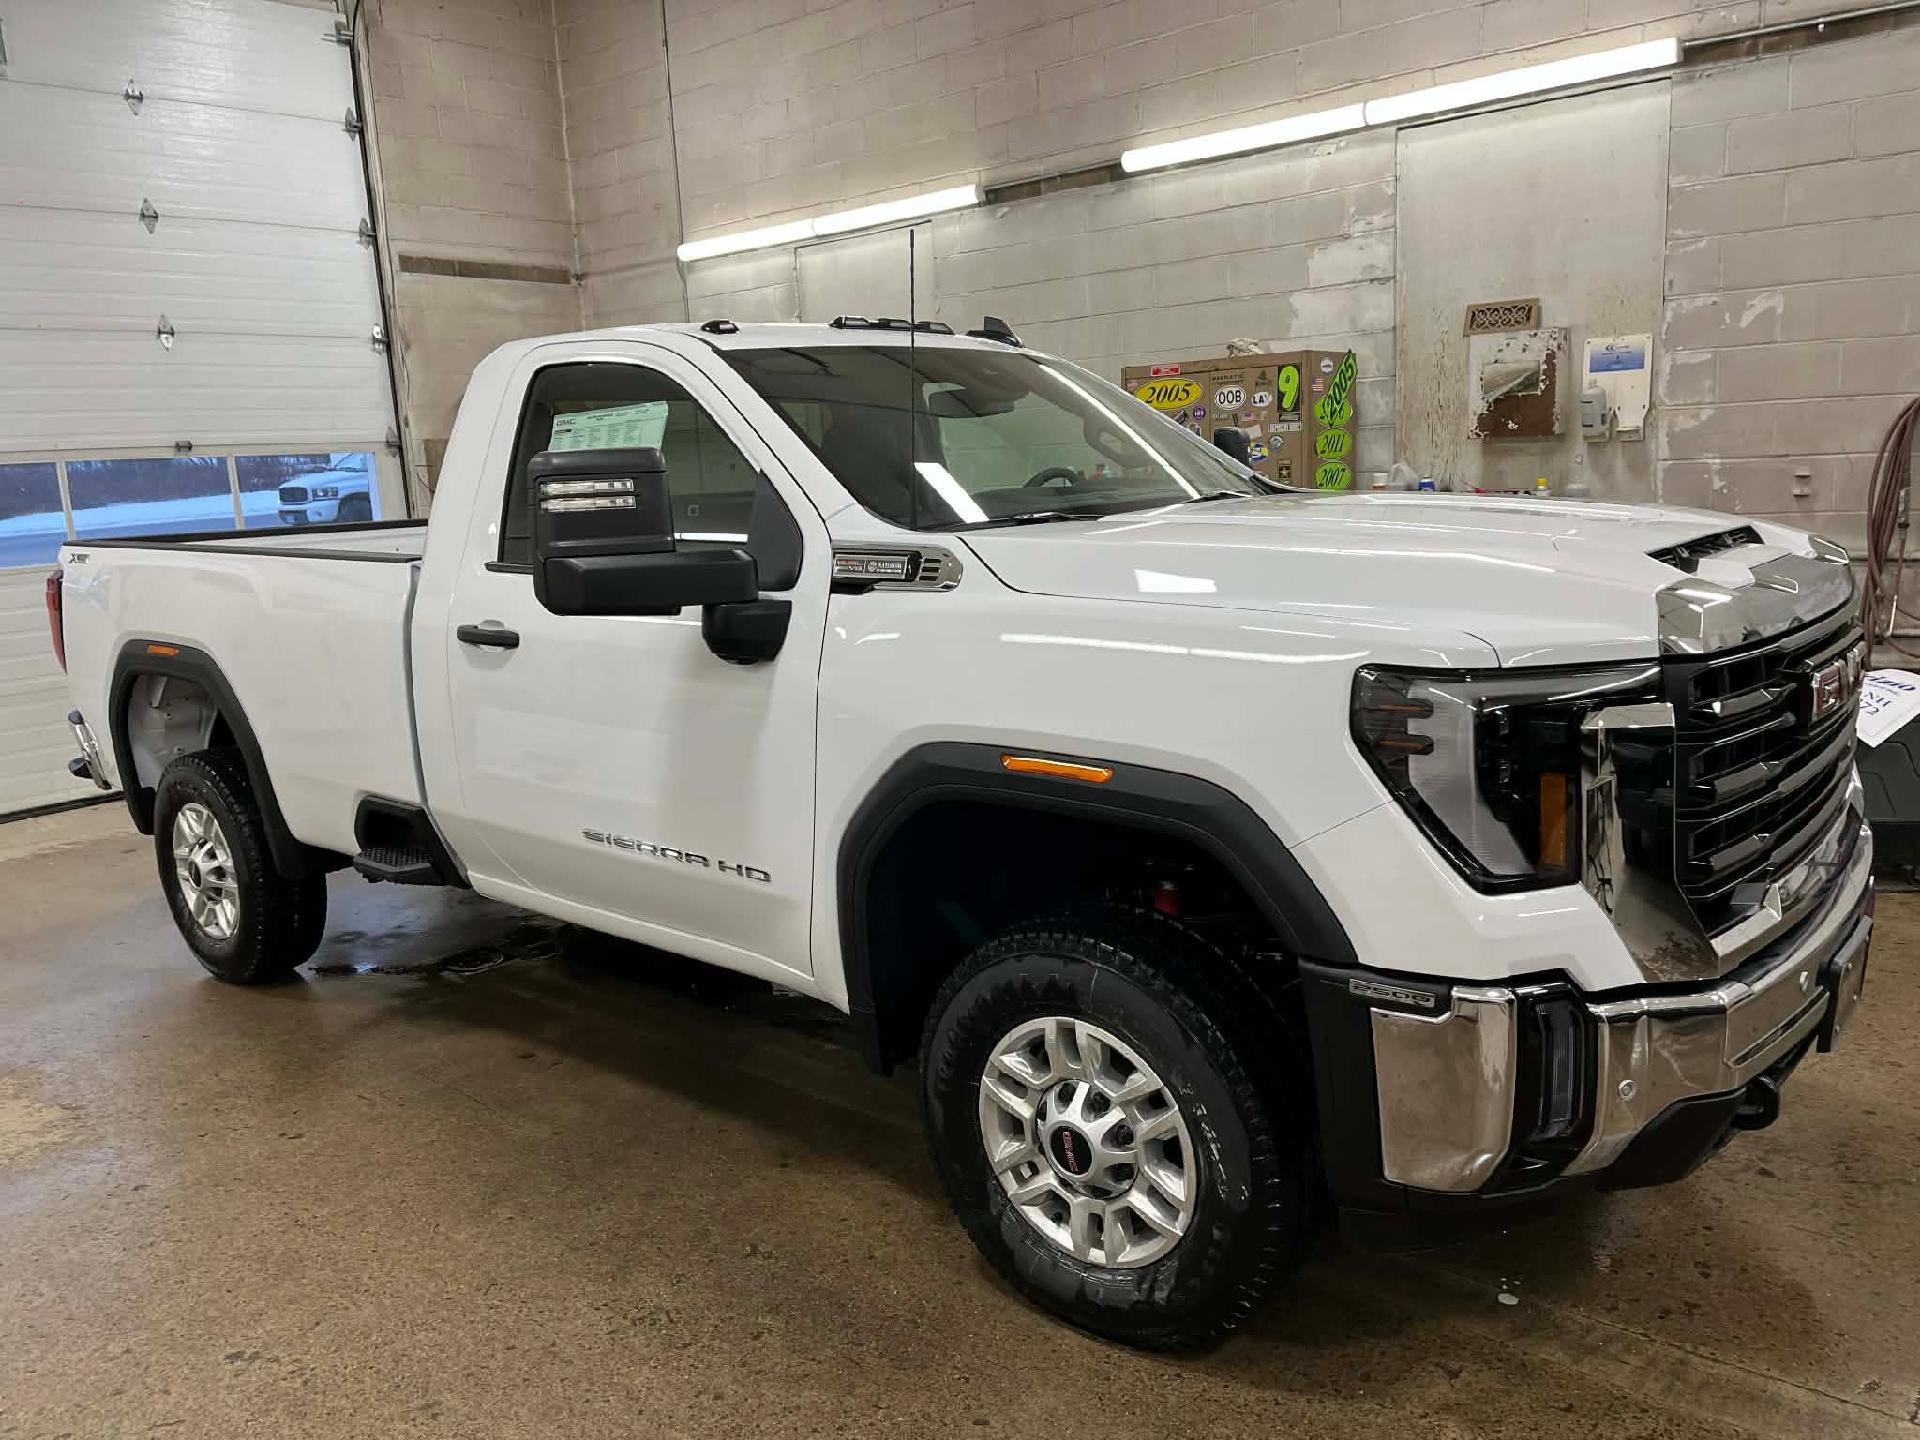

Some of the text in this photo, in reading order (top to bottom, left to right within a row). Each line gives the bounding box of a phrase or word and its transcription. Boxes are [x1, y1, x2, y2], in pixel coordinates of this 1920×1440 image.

[1145, 383, 1193, 403] 2005
[1279, 365, 1299, 409] 9
[1320, 434, 1345, 454] 2011
[582, 828, 772, 882] SIERRA HD
